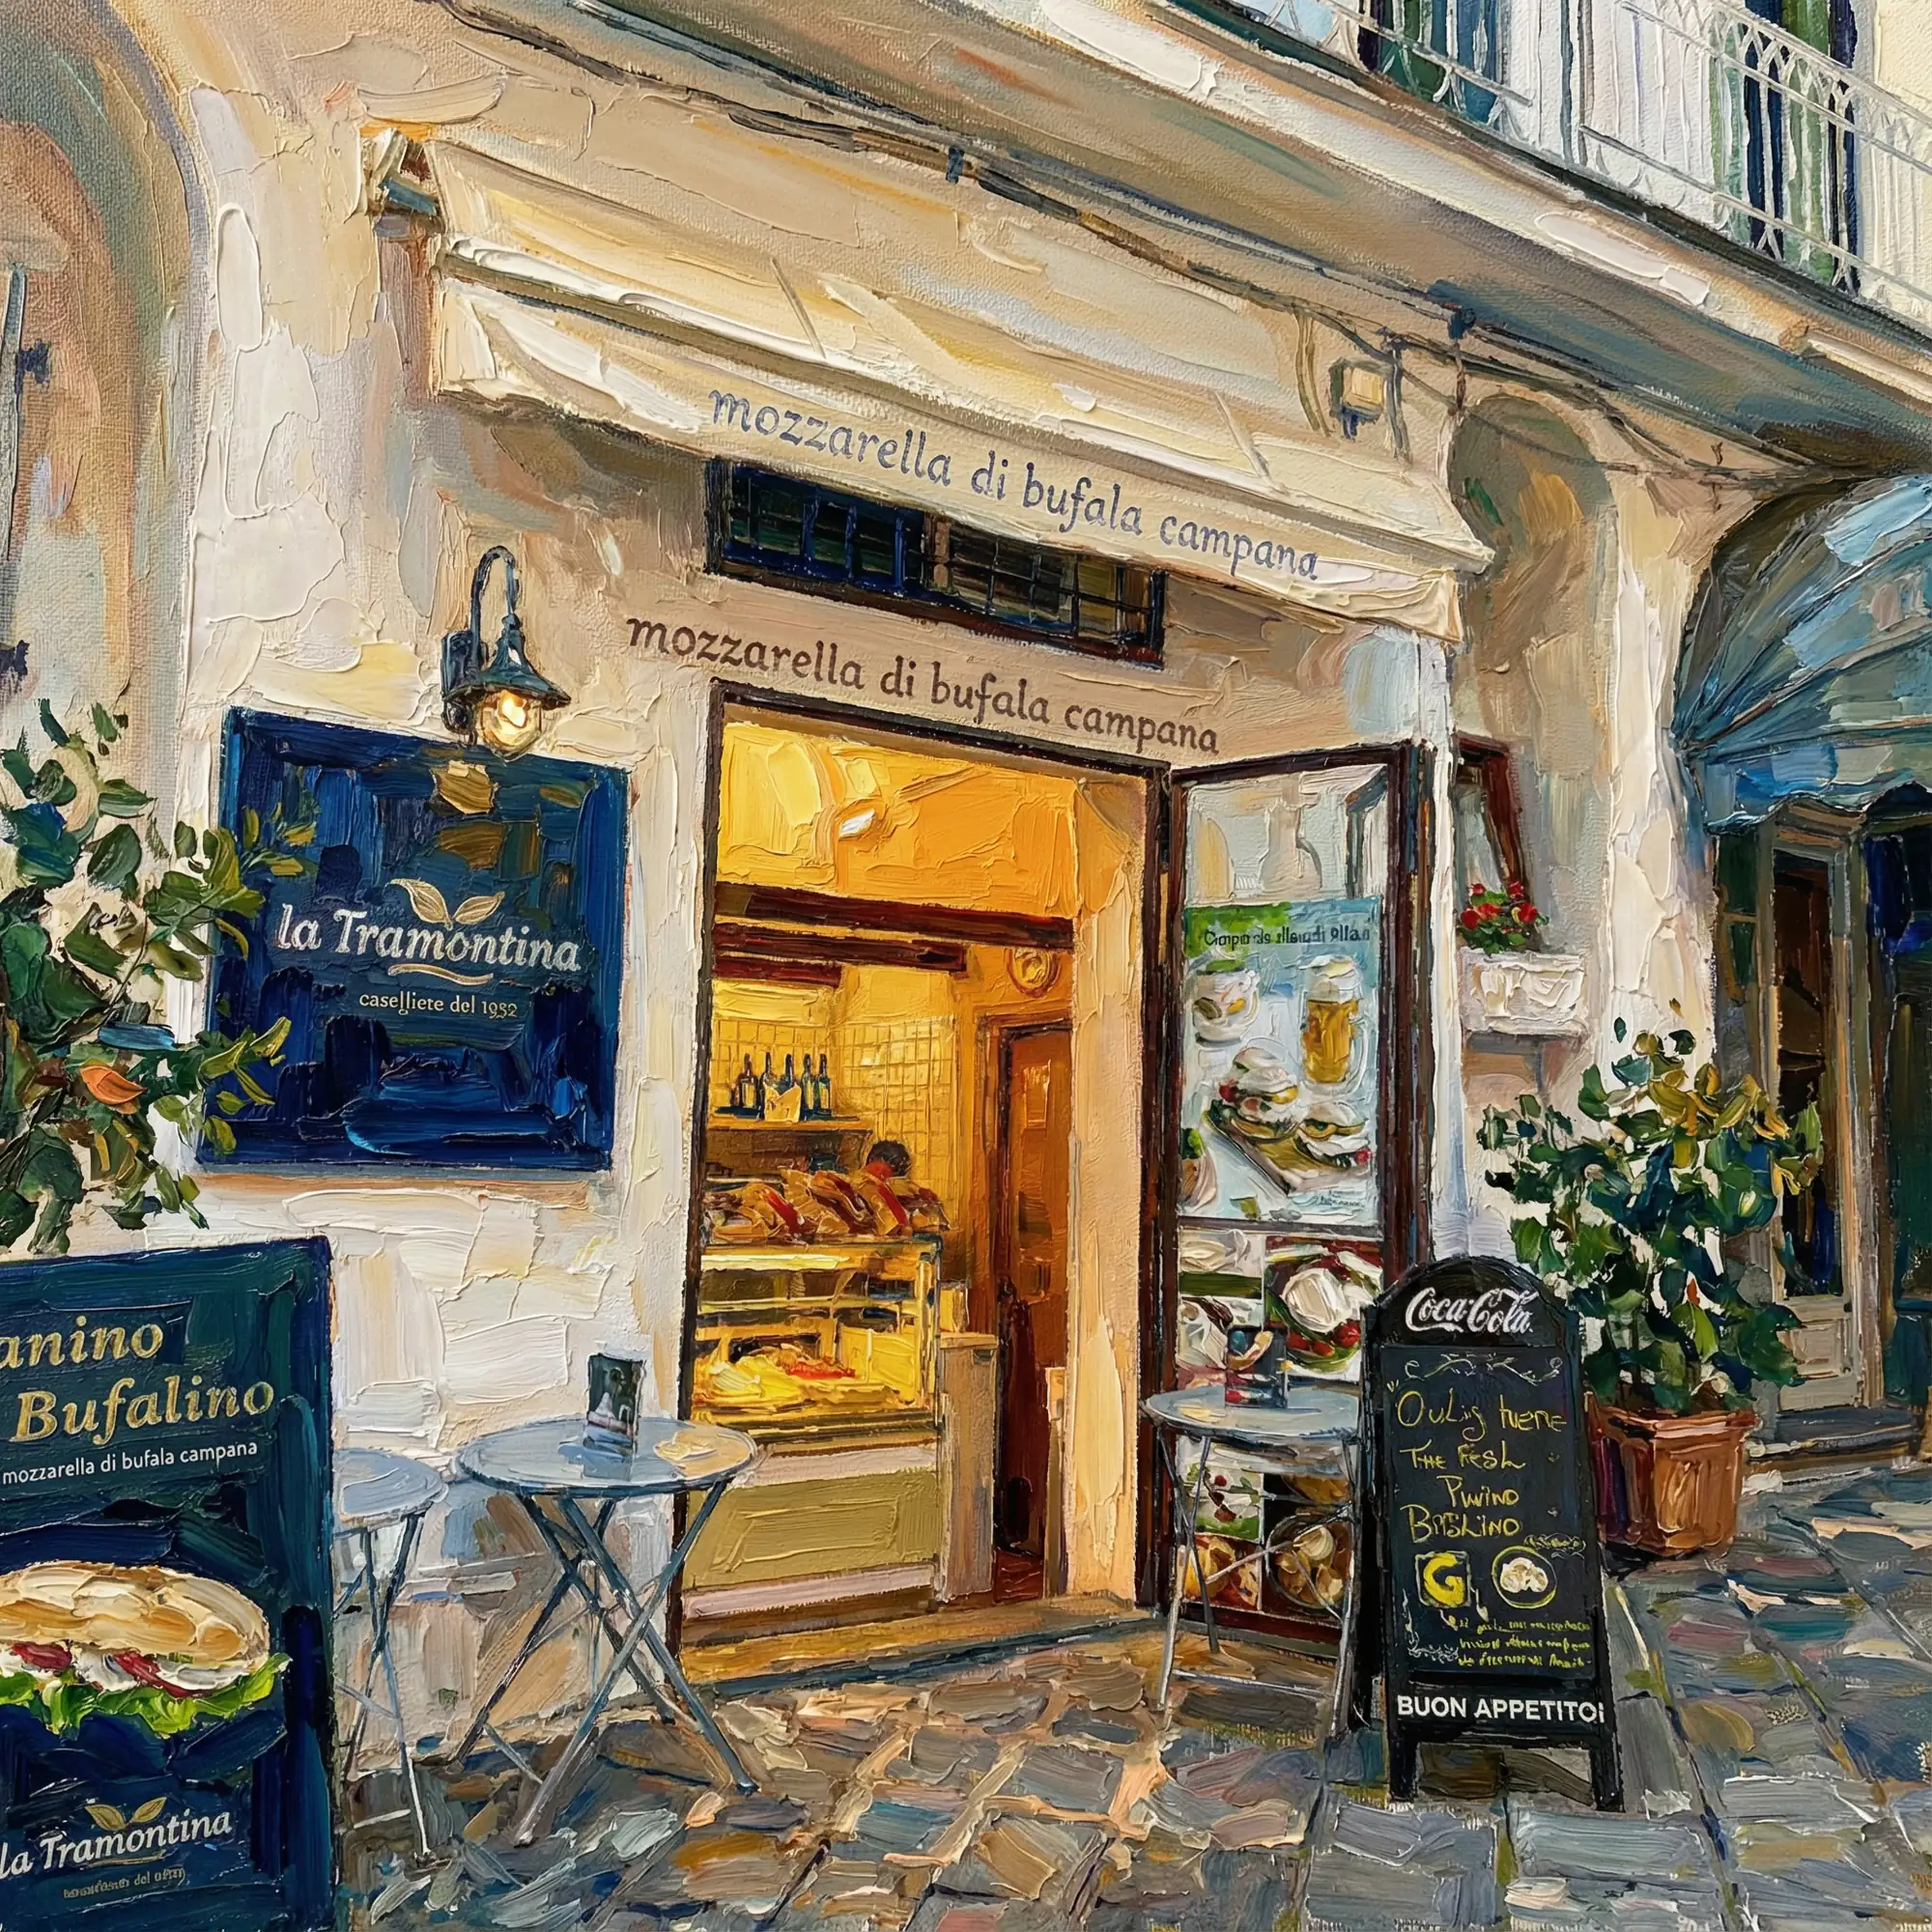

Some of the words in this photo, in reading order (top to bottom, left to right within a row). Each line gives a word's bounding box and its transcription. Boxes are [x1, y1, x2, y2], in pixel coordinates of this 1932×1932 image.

[708, 389, 952, 485] mozzarella
[971, 450, 1008, 500] di
[1025, 463, 1142, 534] bufala
[1159, 515, 1320, 581] campana
[627, 616, 866, 690] mozzarella
[880, 655, 914, 697] di
[931, 661, 1051, 724] bufala
[1065, 704, 1220, 755] campana
[275, 903, 322, 951] la
[332, 909, 582, 972] Tramontina
[449, 995, 476, 1013] del
[10, 1375, 274, 1445] Bufalino
[2, 1457, 96, 1485] mozzarella
[99, 1451, 117, 1473] di
[122, 1447, 175, 1471] bufala
[180, 1441, 258, 1468] campana
[1397, 1694, 1466, 1718] BUON
[0, 1841, 34, 1880] la
[40, 1808, 232, 1869] Tramontina
